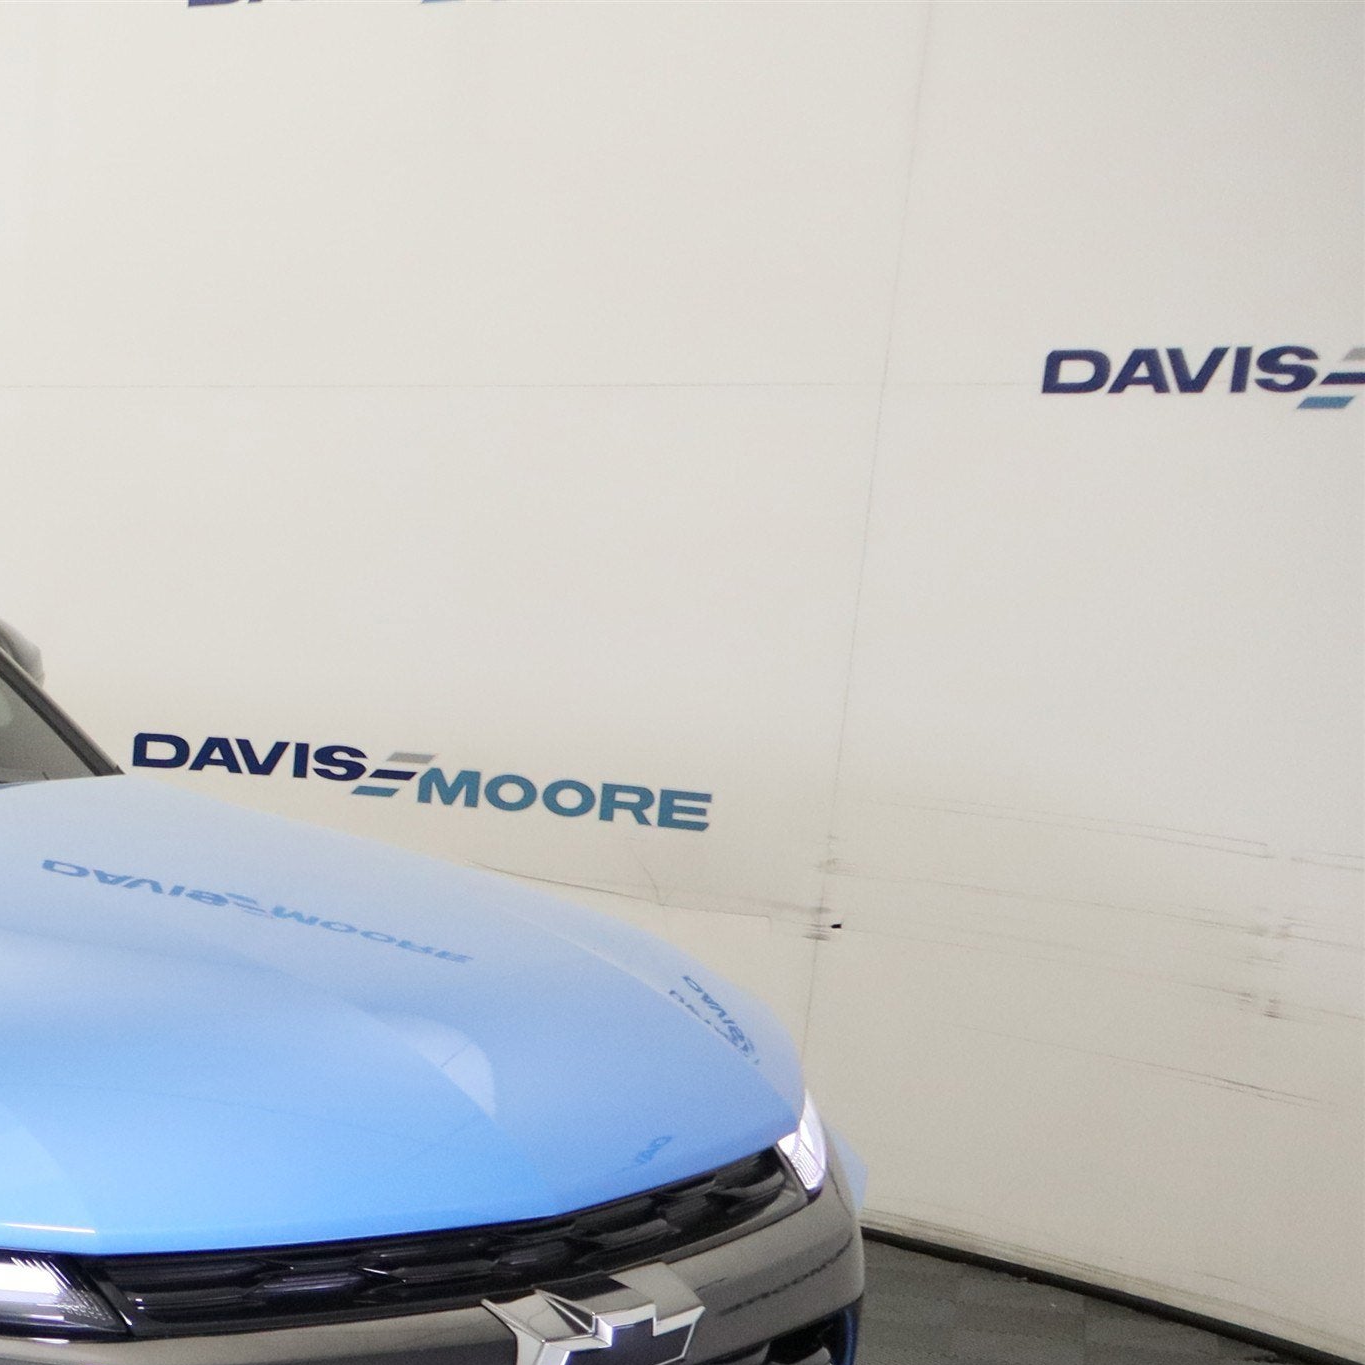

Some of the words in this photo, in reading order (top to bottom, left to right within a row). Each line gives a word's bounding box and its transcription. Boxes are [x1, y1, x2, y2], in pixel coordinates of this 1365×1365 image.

[1040, 345, 1320, 394] DAVIS
[132, 732, 370, 781] DAVIS
[416, 767, 713, 832] MOORE
